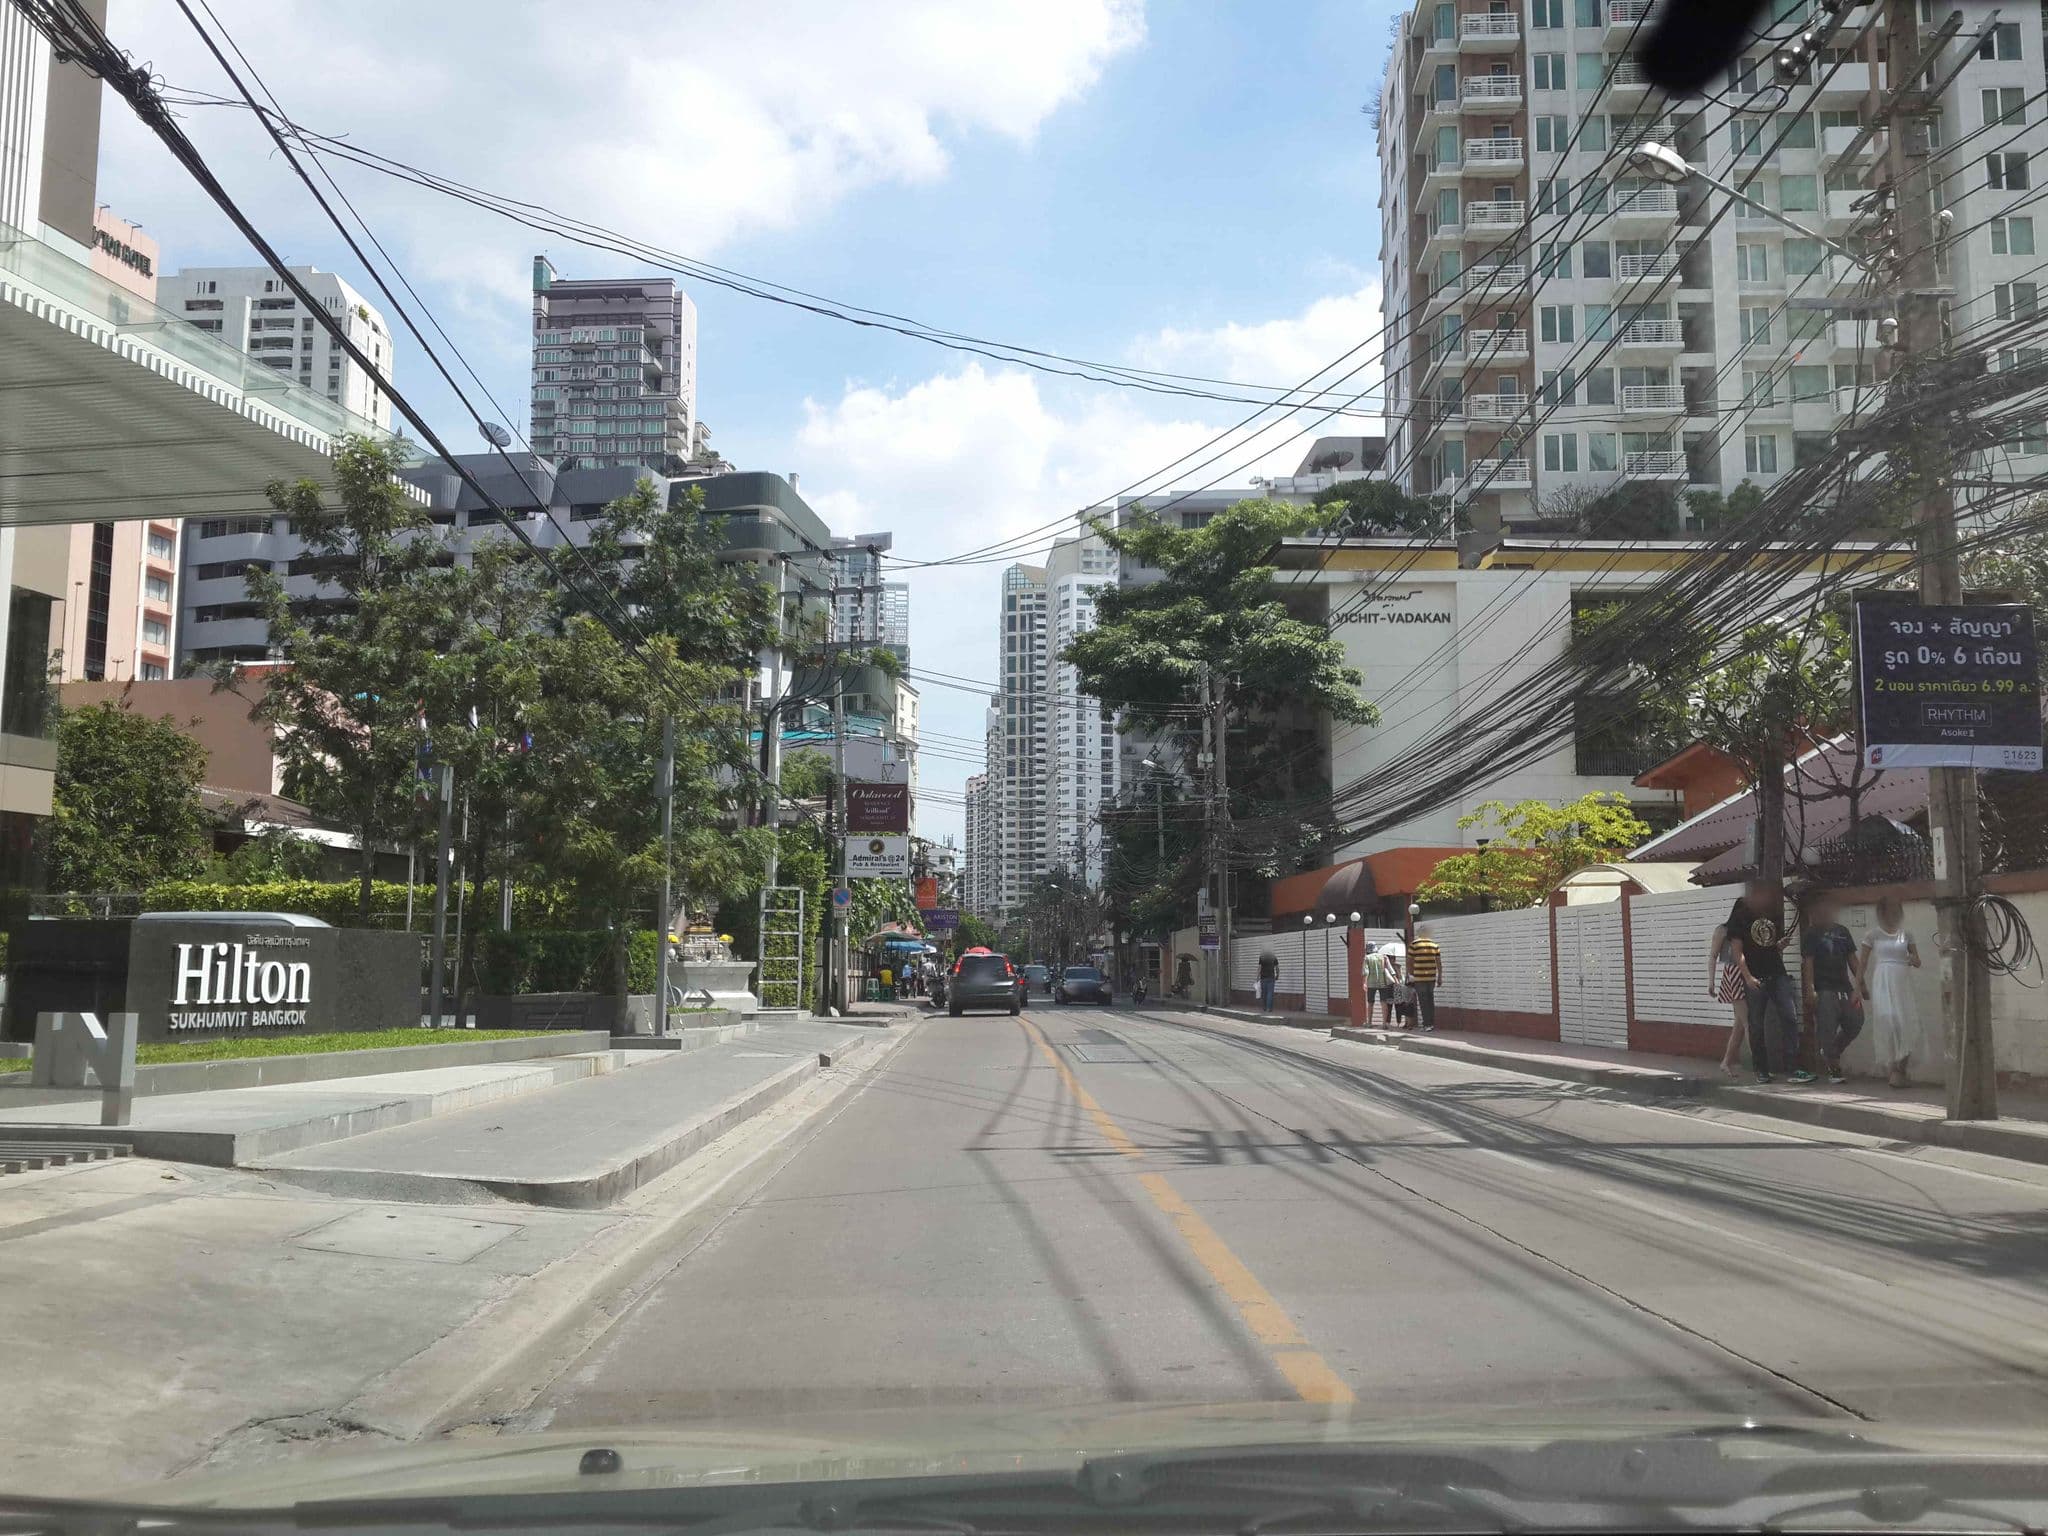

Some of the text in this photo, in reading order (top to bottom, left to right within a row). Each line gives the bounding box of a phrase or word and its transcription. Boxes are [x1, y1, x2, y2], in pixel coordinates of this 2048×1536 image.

[121, 244, 153, 278] HOTEL
[1336, 612, 1451, 624] VICHIT-VADAKAN
[1889, 618, 2012, 638] จอง + สัญญา
[1884, 646, 2022, 670] รูด 0% 6 เดือน
[1875, 678, 1884, 691] 2
[1888, 681, 1914, 691] นอน
[1918, 680, 1977, 692] ราคาเดียว
[1981, 680, 2014, 692] 6.99
[1927, 708, 1986, 721] RHYTHM
[1940, 728, 1968, 737] Asoke
[2011, 750, 2037, 760] 1623
[173, 942, 311, 1005] Hilton
[169, 1010, 307, 1029] SUKHUMVIT BANGKOK
